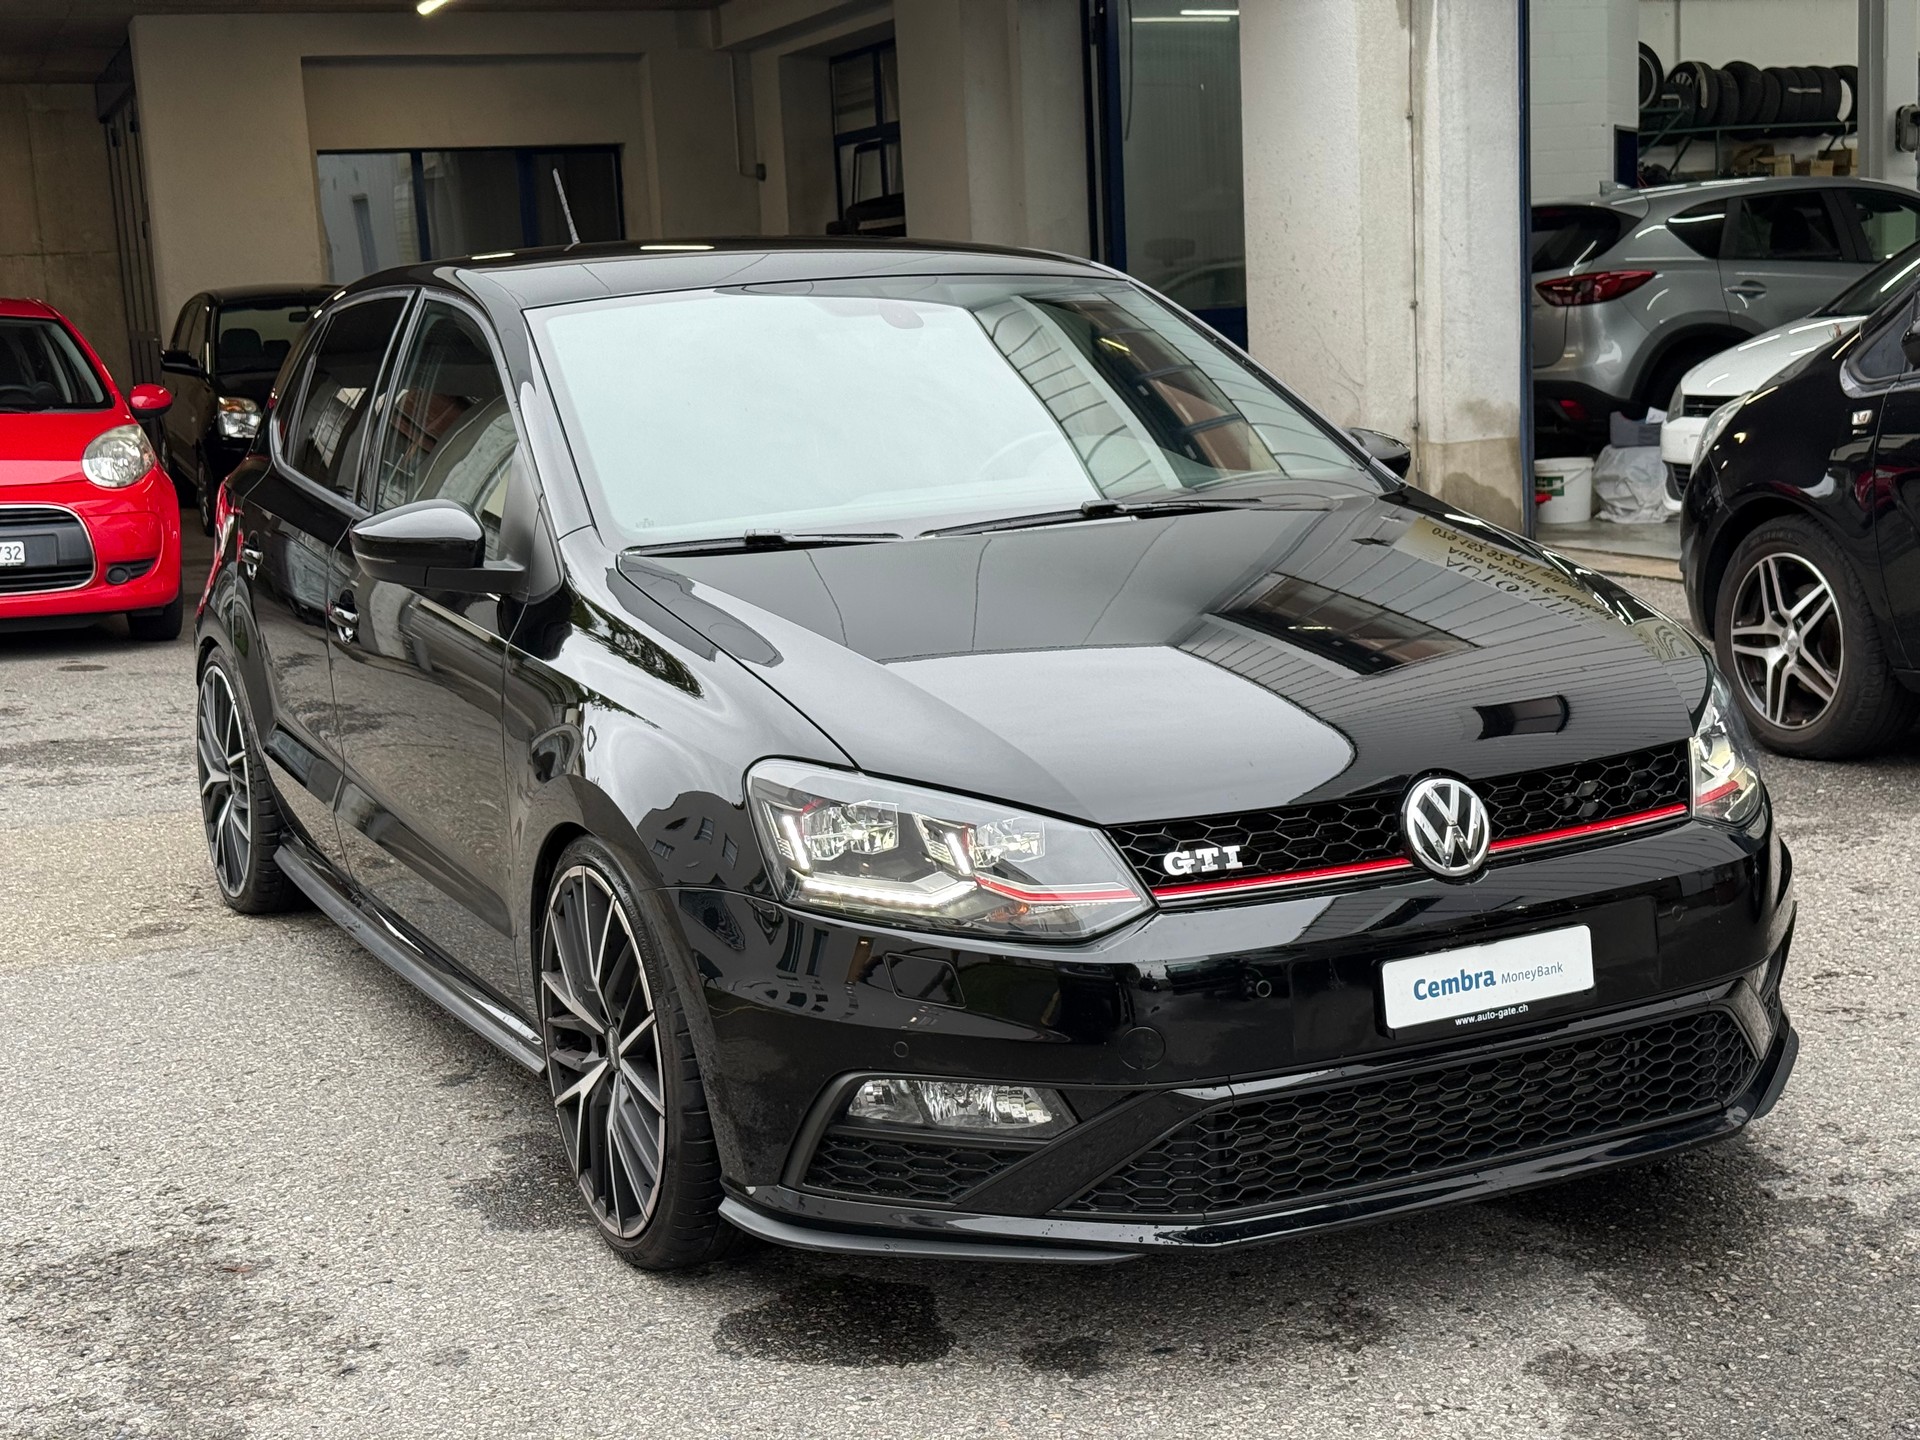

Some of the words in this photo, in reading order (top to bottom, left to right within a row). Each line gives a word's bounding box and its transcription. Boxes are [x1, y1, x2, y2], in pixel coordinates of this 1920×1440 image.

[1163, 845, 1244, 876] GTI
[1414, 969, 1496, 1000] Cembra
[1501, 962, 1563, 984] MoneyBank
[1455, 1004, 1529, 1025] www.auto-gate.ch
